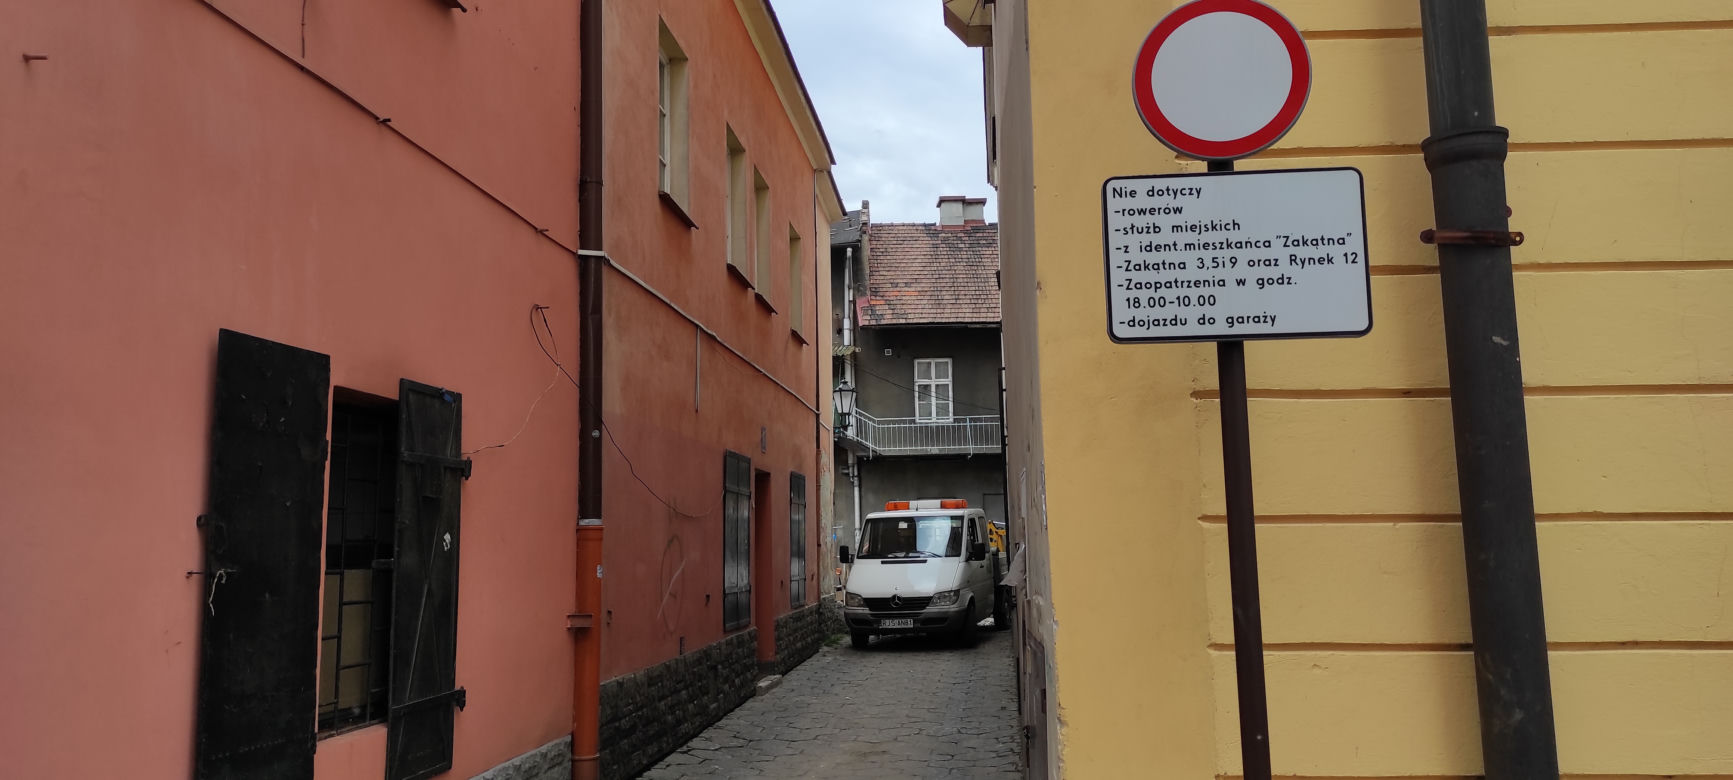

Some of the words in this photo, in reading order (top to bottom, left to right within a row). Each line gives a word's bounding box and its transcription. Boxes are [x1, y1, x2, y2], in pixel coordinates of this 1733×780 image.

[1112, 186, 1138, 200] Nie
[1146, 185, 1203, 201] dotyczy
[1113, 202, 1184, 217] -rowerów
[1113, 221, 1162, 236] -służb
[1171, 218, 1241, 236] miejskich
[1114, 244, 1130, 254] -z
[1115, 258, 1187, 275] -Zakątna
[1247, 257, 1280, 268] oraz
[1288, 252, 1335, 270] Rynek
[1342, 251, 1359, 265] 12
[1116, 276, 1227, 294] -Zaopatrzenia
[1234, 277, 1247, 288] w
[1255, 272, 1298, 290] godz.
[1125, 293, 1217, 310] 18.00-10.00
[1118, 313, 1188, 331] -dojazdu
[1196, 313, 1217, 326] do
[1225, 310, 1277, 329] garaży
